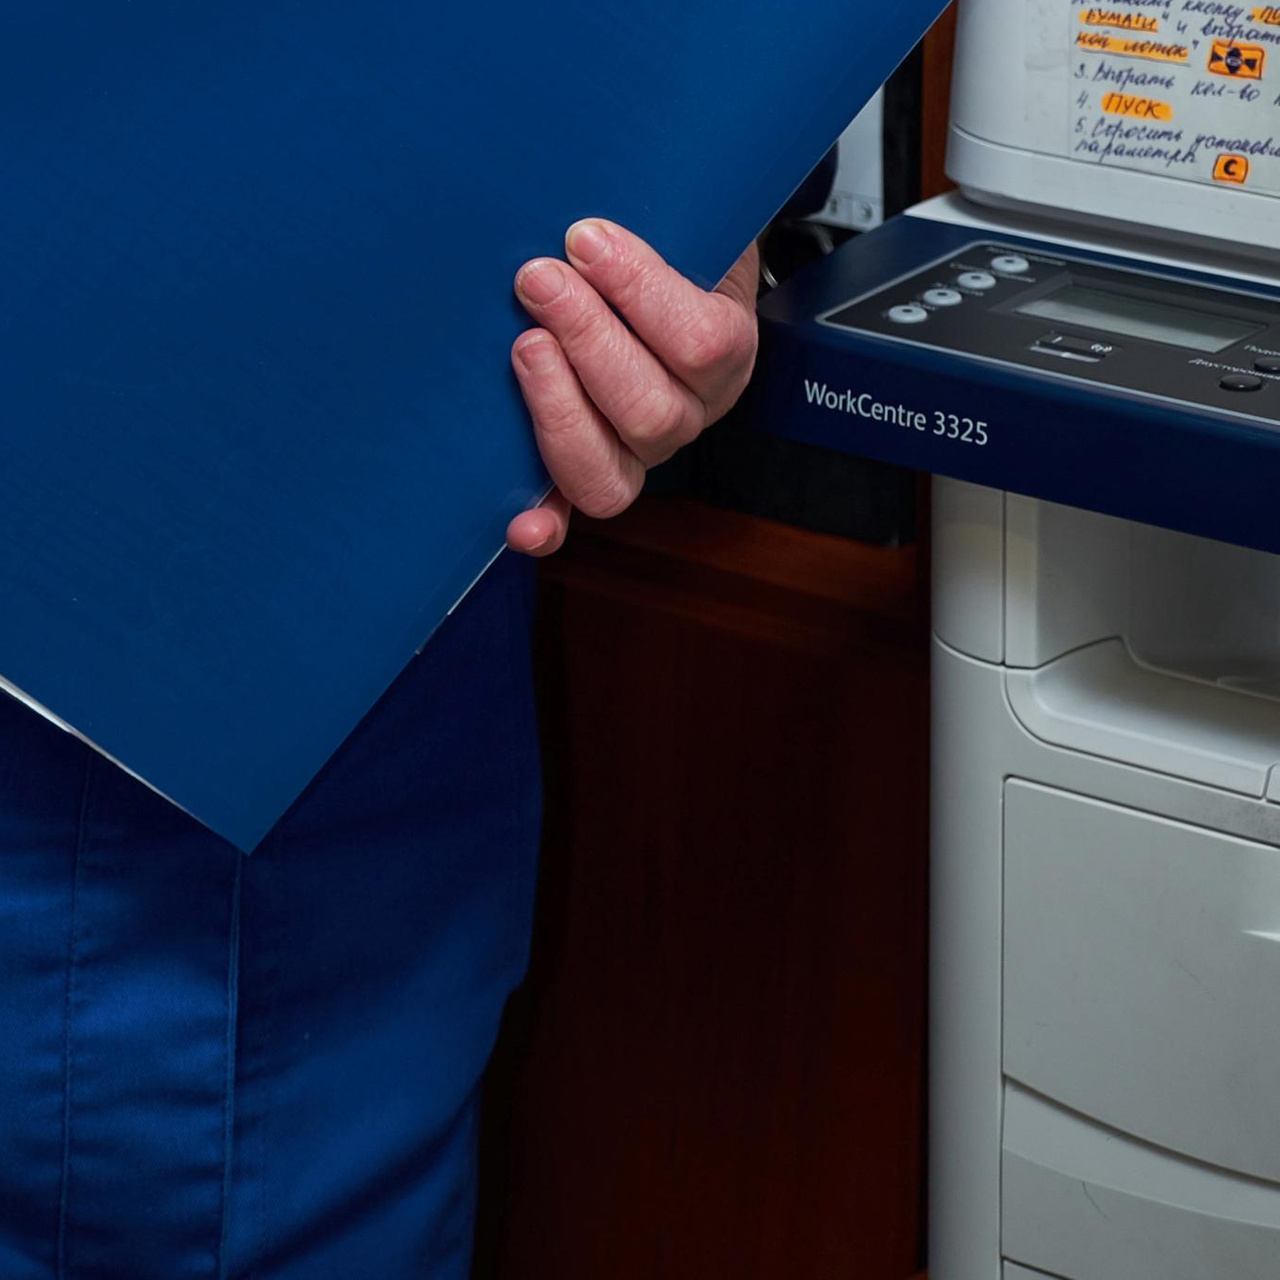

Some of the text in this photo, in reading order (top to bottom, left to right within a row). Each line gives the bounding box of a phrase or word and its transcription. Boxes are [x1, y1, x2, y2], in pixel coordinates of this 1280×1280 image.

[1105, 92, 1161, 120] ПУСК
[805, 379, 988, 446] WorkCentre 3325
